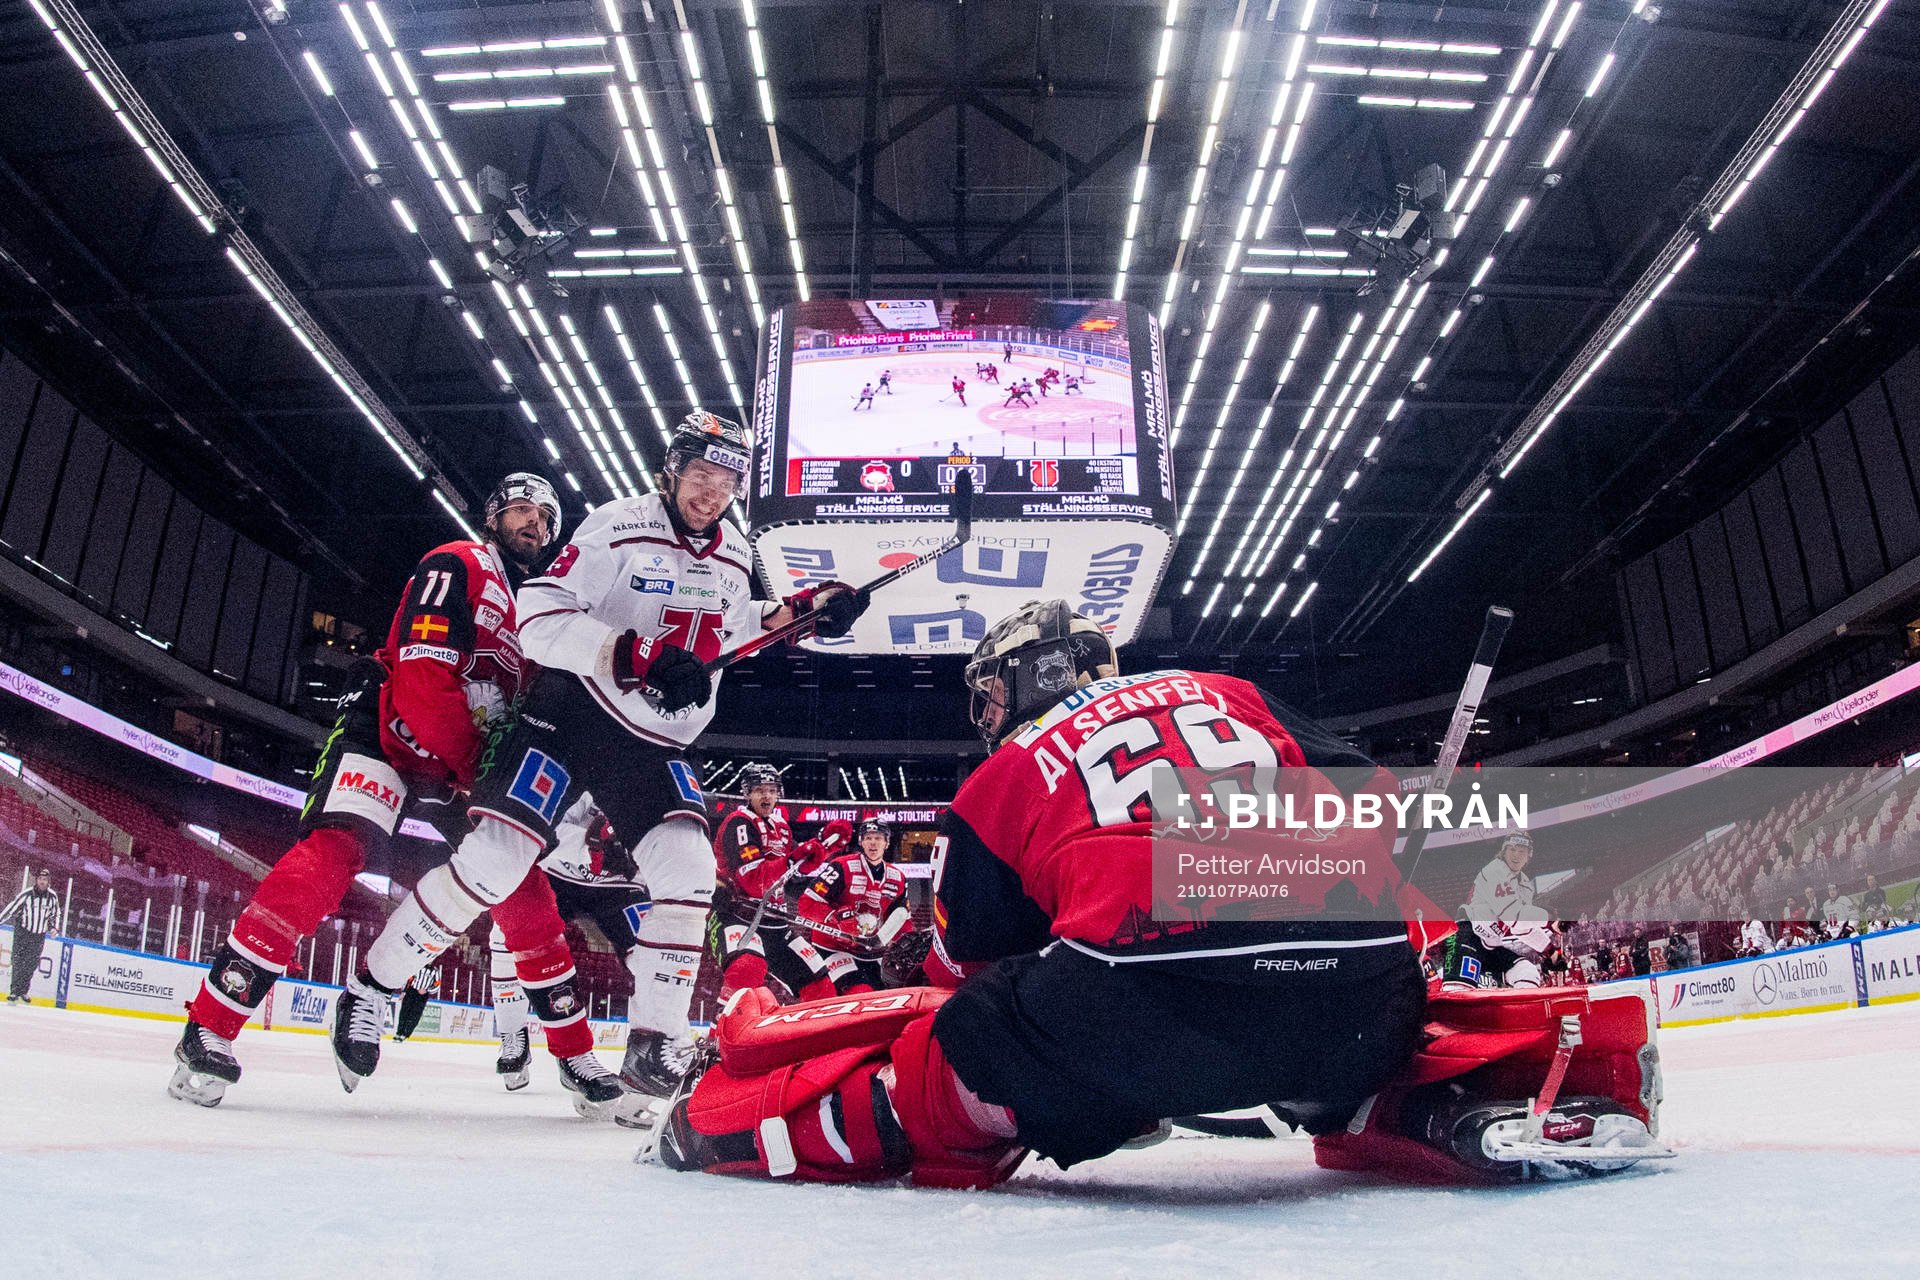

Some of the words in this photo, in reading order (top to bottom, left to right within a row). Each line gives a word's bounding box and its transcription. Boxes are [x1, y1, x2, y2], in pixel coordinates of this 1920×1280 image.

[901, 461, 911, 477] 0
[1016, 461, 1023, 476] 1
[855, 495, 904, 505] MALMÖ
[1061, 495, 1109, 504] MALMÖ
[816, 503, 950, 513] STÄLLNINGSSERVICE
[1022, 503, 1152, 515] STÄLLNINGSSERVICE
[419, 570, 453, 607] 11
[644, 581, 671, 592] BRL
[1075, 702, 1282, 827] 69
[338, 771, 401, 809] MAXI
[821, 810, 858, 821] KVALITET
[897, 810, 937, 822] STOLTHET
[737, 824, 749, 846] 8
[820, 865, 840, 885] 22
[794, 915, 843, 938] BAUER
[247, 934, 275, 953] CCM
[541, 961, 566, 974] CCM
[1254, 957, 1339, 972] PREMIER
[1777, 954, 1828, 984] Malmö
[1872, 954, 1920, 983] MAL
[108, 965, 143, 980] MALMÖ
[75, 972, 174, 997] STÄLLNINGSSERVICE
[1689, 976, 1736, 998] Climat80
[1800, 987, 1820, 1000] Born
[1820, 986, 1829, 997] to
[755, 994, 914, 1029] CCM
[1549, 1122, 1582, 1134] CCM
